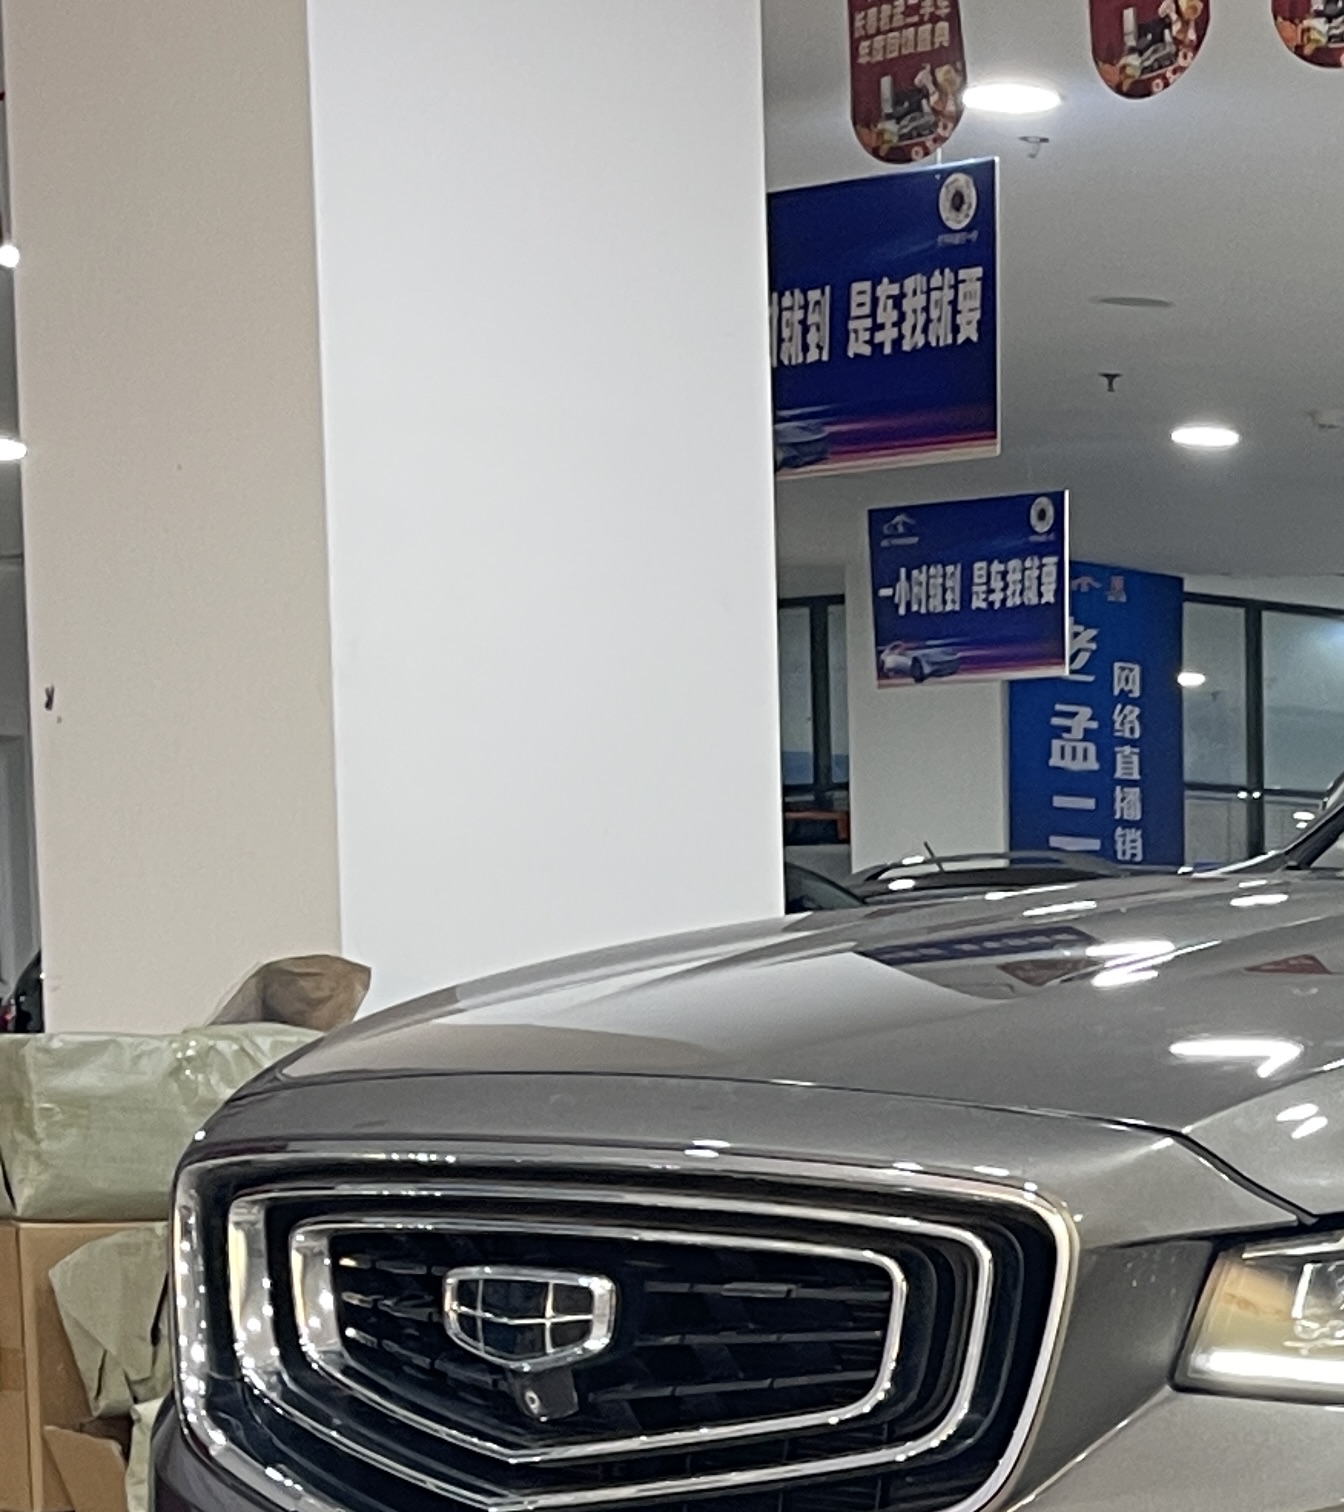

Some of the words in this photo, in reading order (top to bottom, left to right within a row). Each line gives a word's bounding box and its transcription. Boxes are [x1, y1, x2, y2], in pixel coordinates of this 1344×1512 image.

[847, 266, 983, 358] 是车我就要
[971, 555, 1059, 611] 是车我就要
